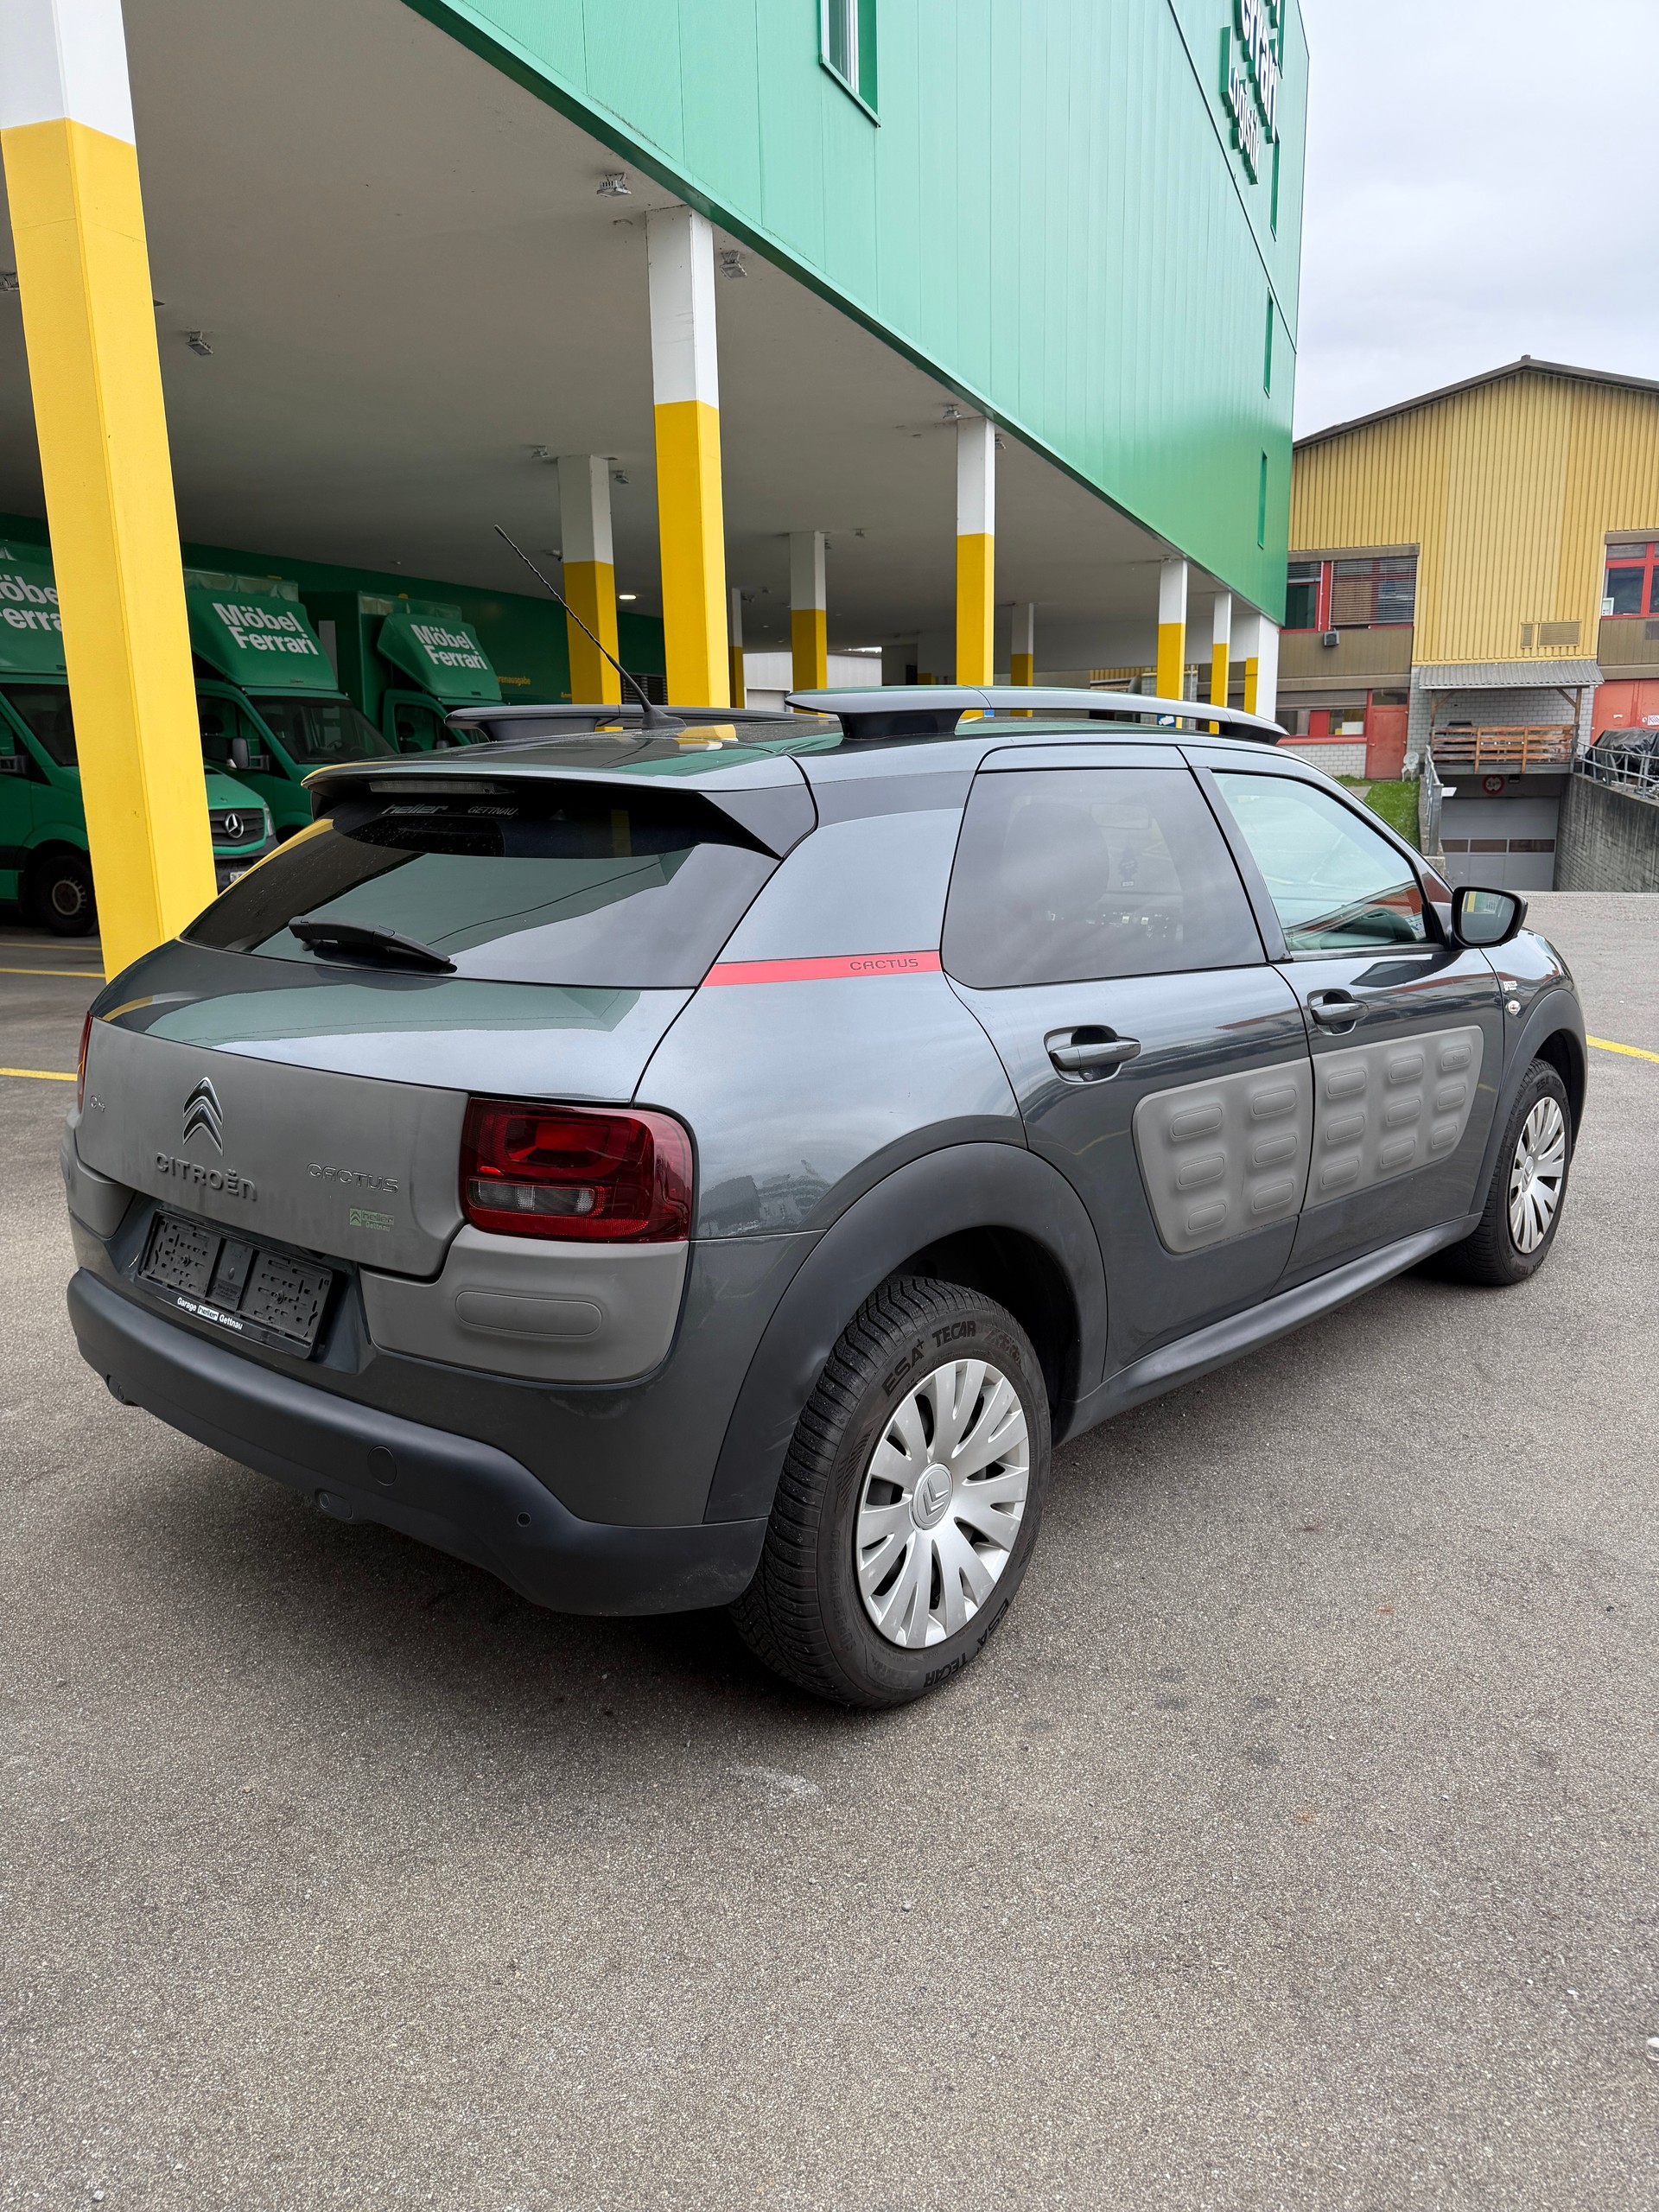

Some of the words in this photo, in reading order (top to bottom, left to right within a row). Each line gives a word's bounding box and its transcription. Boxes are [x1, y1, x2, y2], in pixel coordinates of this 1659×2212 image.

[1227, 27, 1261, 184] Logistik
[212, 602, 304, 632] Möbel
[228, 626, 319, 656] Ferrari
[410, 624, 475, 650] Möbel
[423, 645, 488, 670] Ferrari
[381, 804, 448, 815] heller
[467, 806, 518, 816] GETTNAU
[849, 958, 918, 970] CACTUS
[307, 1162, 398, 1193] CACTUS
[177, 1296, 197, 1312] Garage
[198, 1305, 219, 1320] heller
[219, 1313, 244, 1331] Gettnau
[931, 1320, 976, 1348] TECAR
[923, 1652, 967, 1688] TECAR
